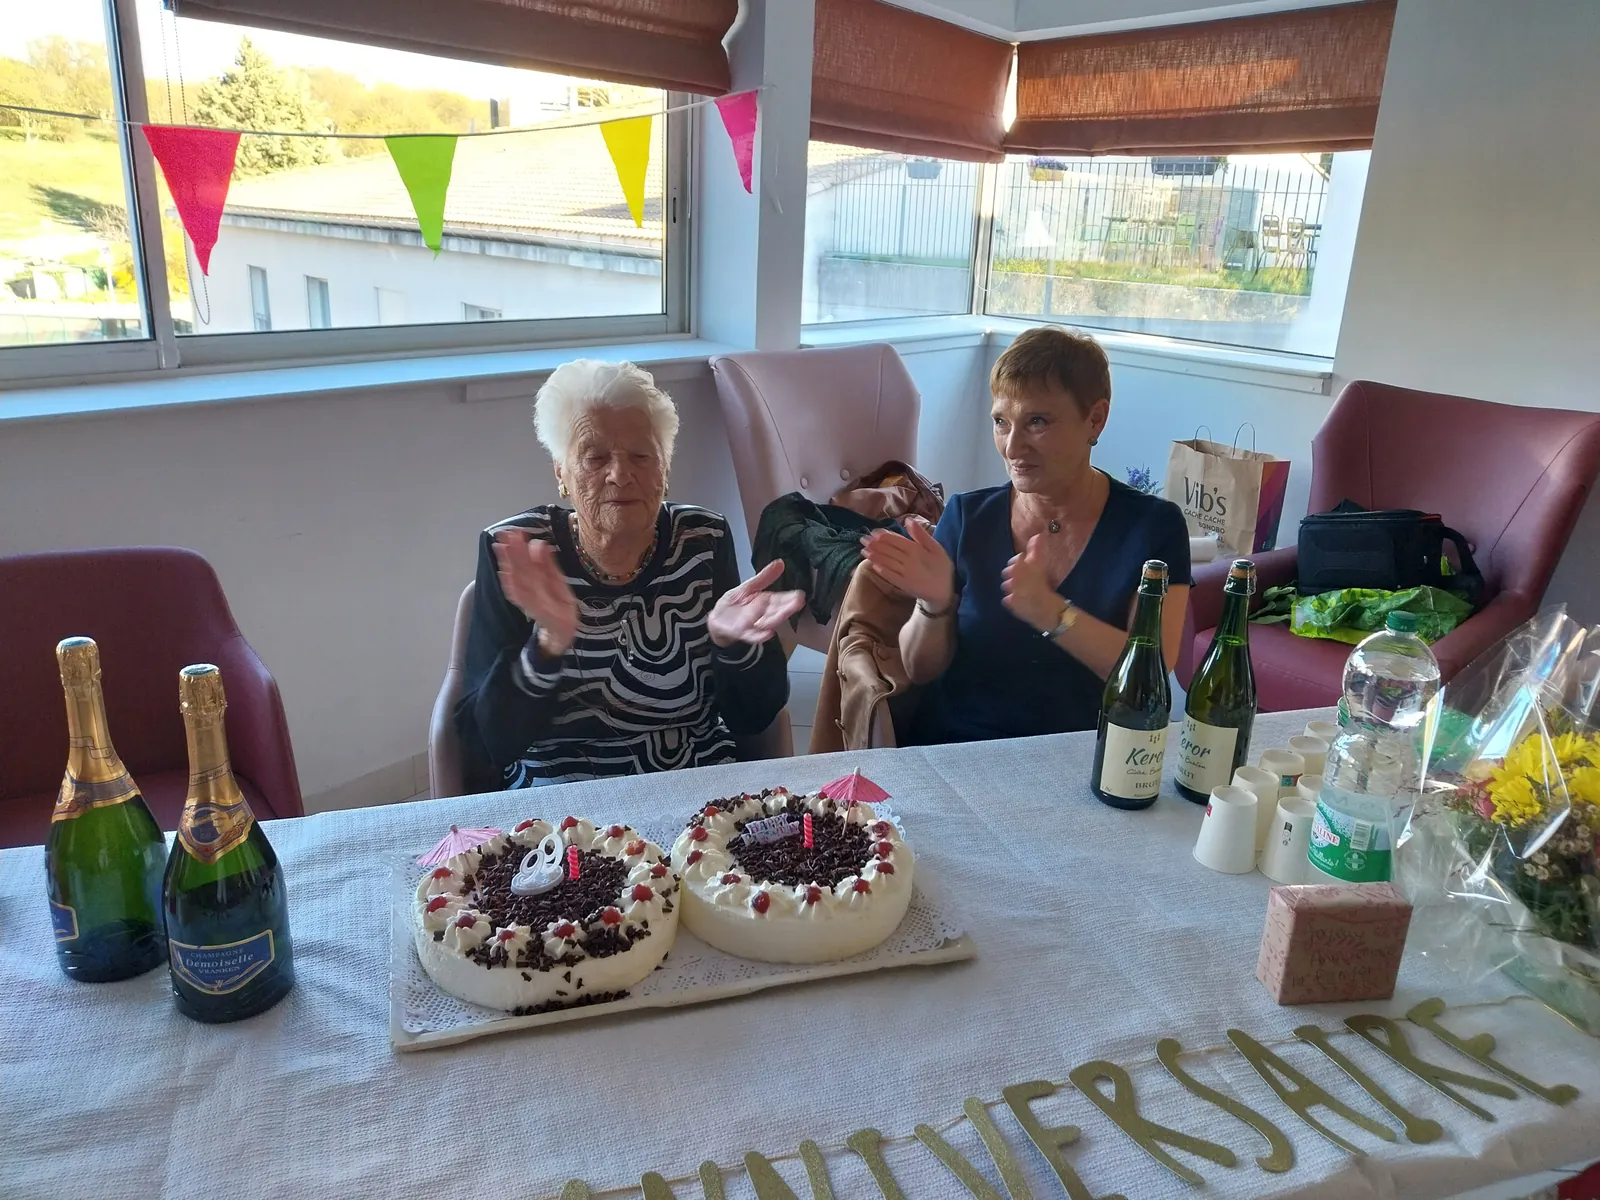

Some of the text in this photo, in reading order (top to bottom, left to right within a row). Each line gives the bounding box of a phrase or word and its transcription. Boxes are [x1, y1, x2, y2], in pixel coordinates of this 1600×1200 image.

[1184, 476, 1226, 516] Vib's
[1184, 509, 1225, 525] CACHE CACHE
[1181, 730, 1211, 758] eror
[1125, 747, 1165, 766] Kero
[186, 953, 254, 968] Demoiselle
[190, 948, 244, 959] CHAMPAGNE
[198, 966, 241, 974] VRANKEN
